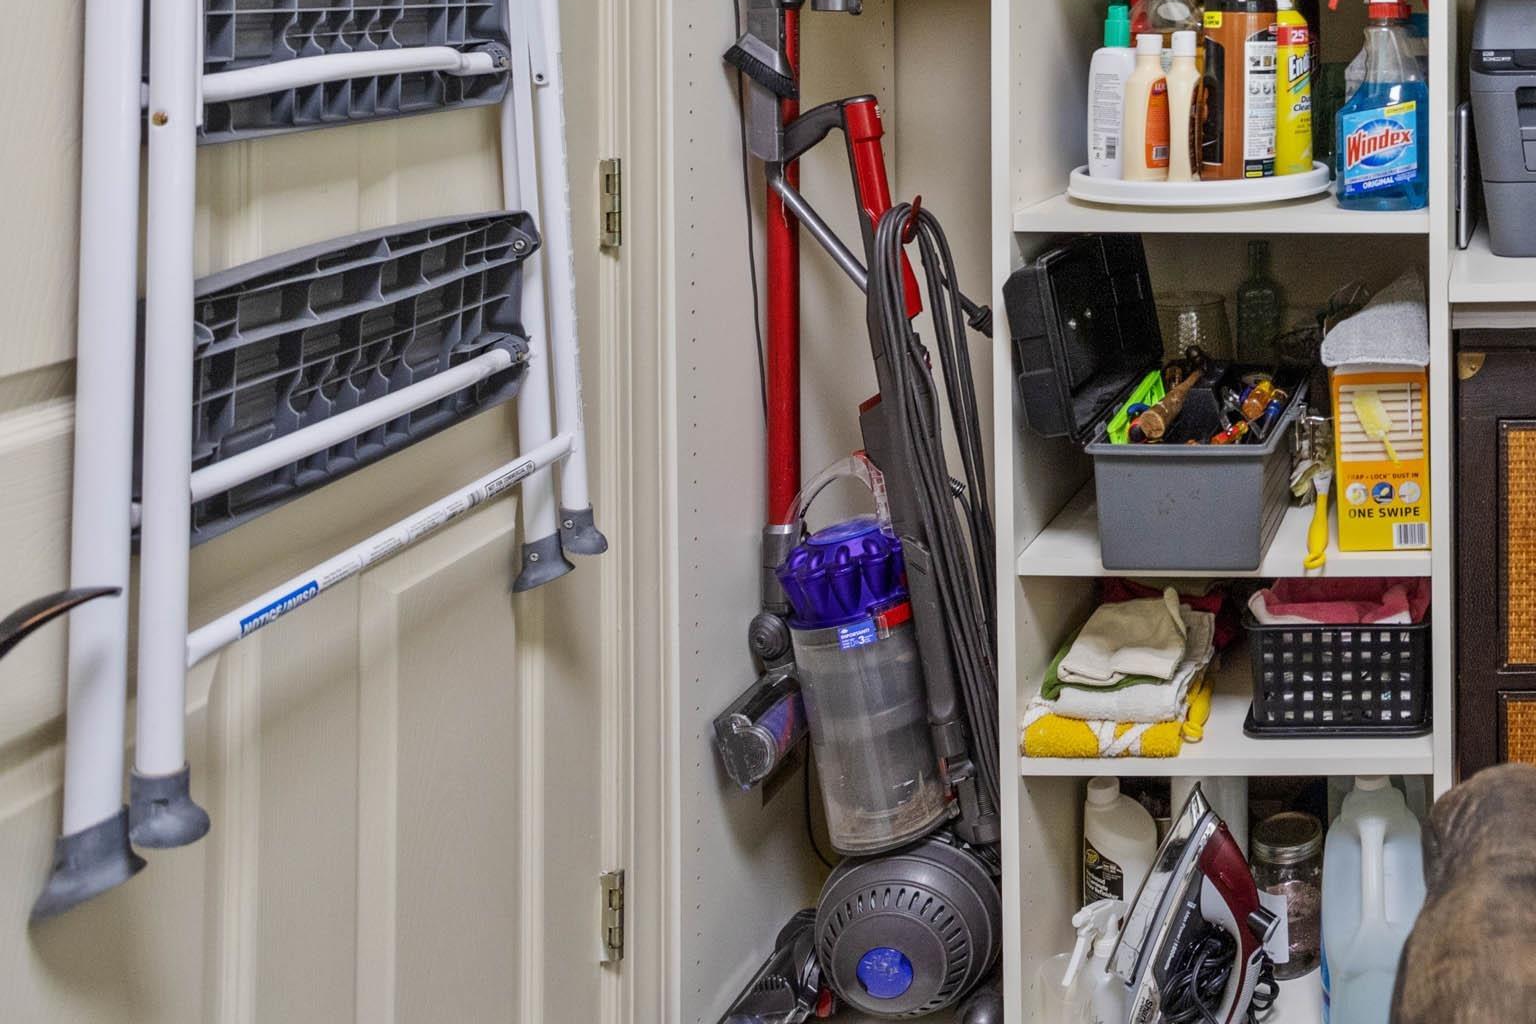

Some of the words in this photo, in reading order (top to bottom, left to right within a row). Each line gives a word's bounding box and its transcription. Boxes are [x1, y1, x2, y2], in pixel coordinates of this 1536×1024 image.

[1347, 127, 1412, 168] Windex
[1362, 178, 1395, 190] ORIGINAL
[1348, 508, 1374, 519] ONE
[1378, 506, 1421, 518] SWIPE
